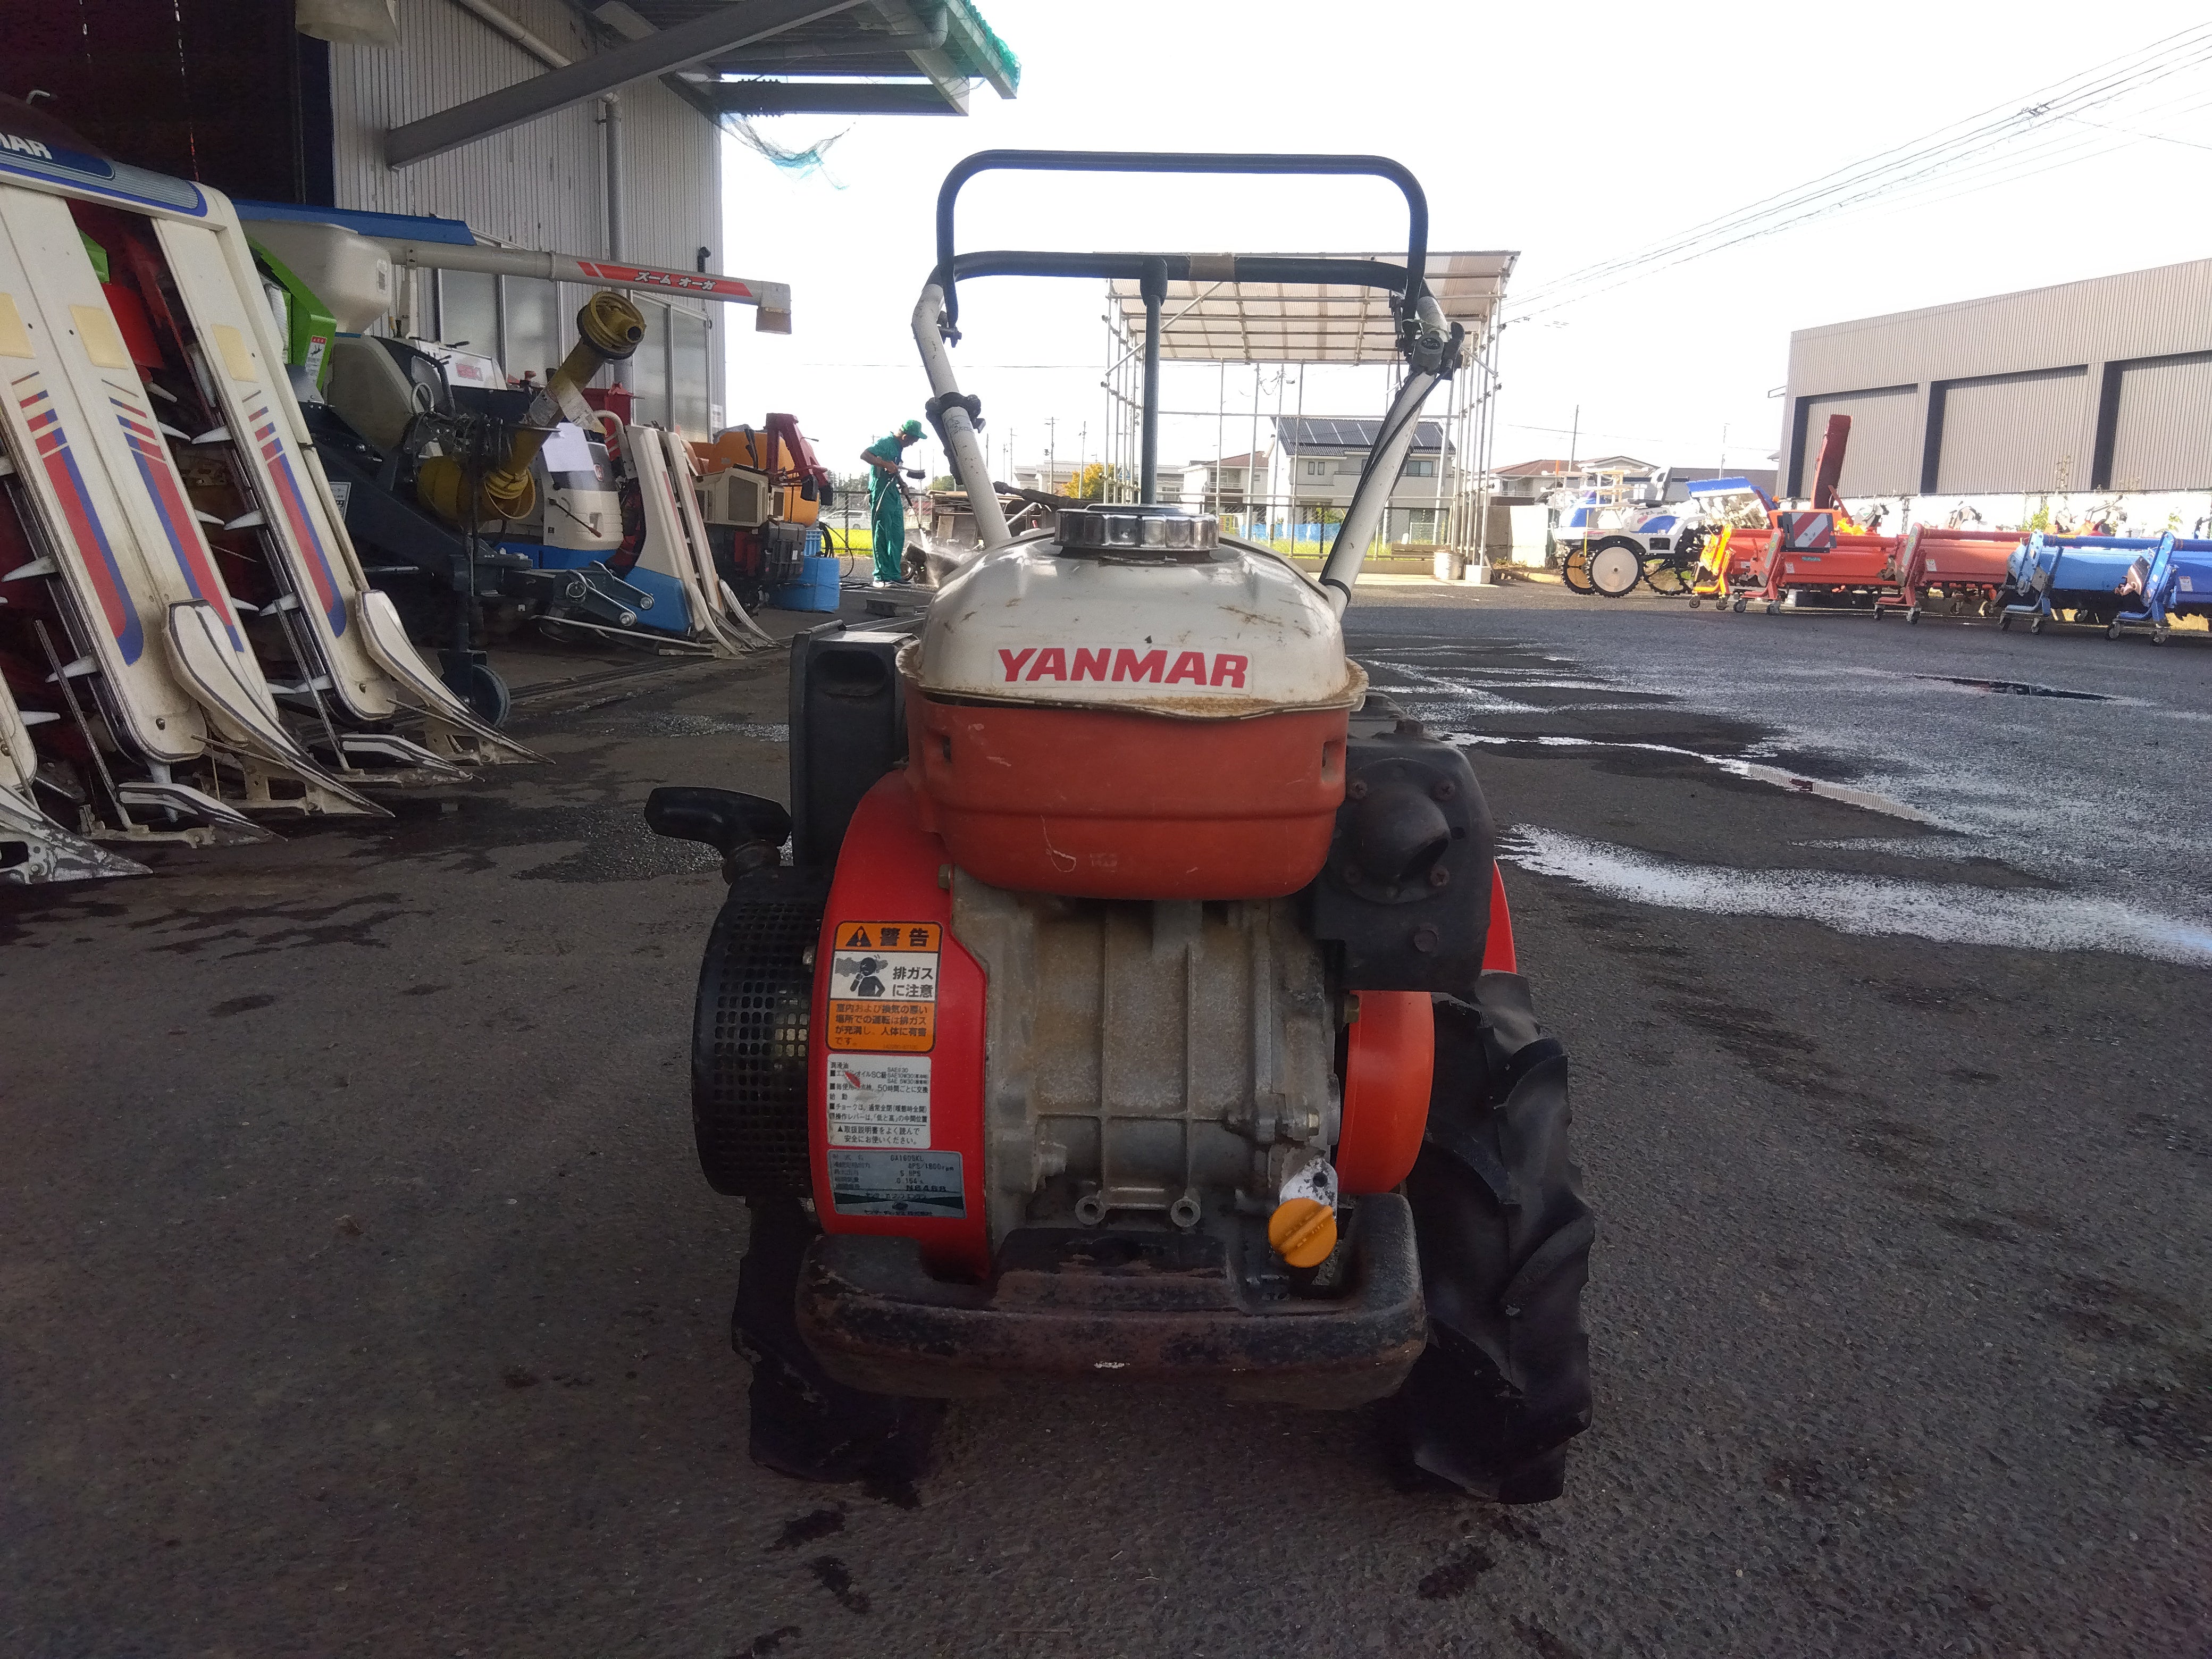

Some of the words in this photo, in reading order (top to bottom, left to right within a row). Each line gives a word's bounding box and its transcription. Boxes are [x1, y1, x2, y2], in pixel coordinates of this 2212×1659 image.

[634, 271, 671, 285] ズーム
[678, 276, 717, 290] オーガ
[998, 648, 1248, 688] YANMAR
[880, 927, 929, 947] 警告
[893, 966, 934, 981] 排ガス
[892, 984, 933, 998] に注意
